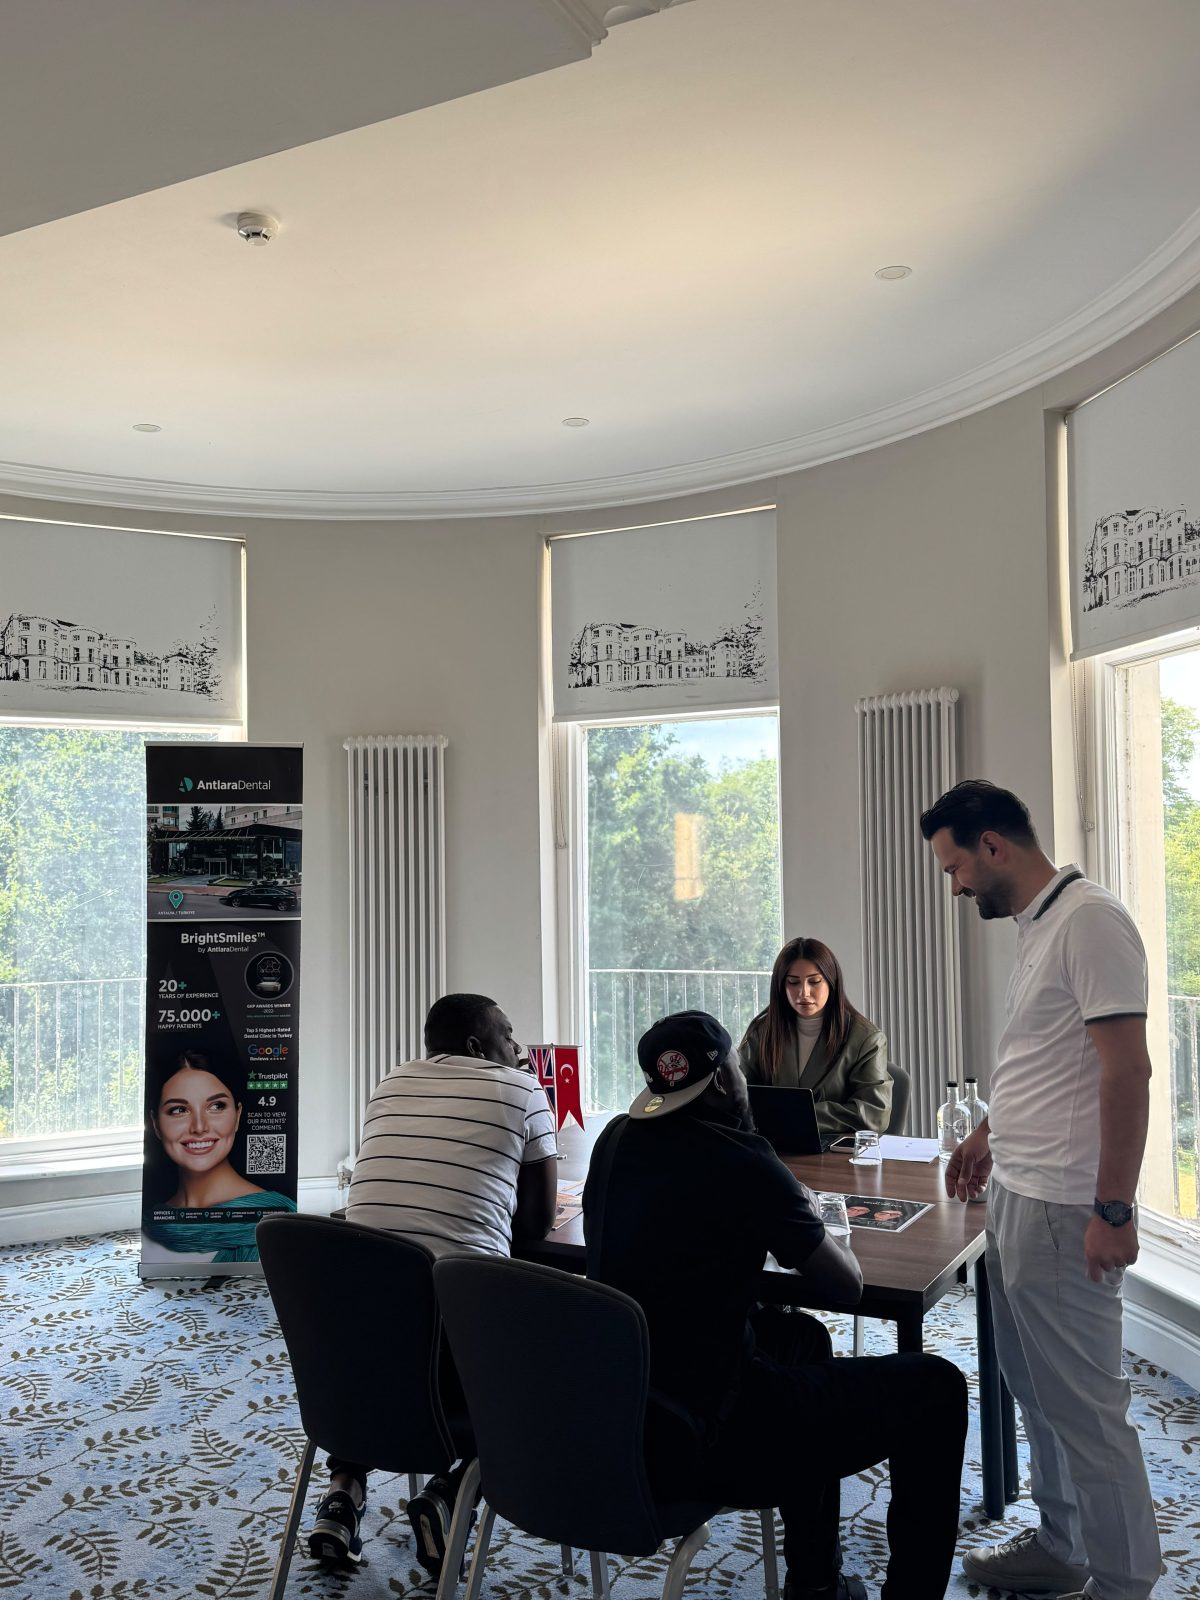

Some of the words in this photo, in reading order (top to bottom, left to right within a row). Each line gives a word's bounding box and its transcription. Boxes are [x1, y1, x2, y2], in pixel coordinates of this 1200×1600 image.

[197, 779, 271, 790] AntlaraDental
[159, 979, 187, 992] 20+
[159, 1009, 220, 1022] 75.000+
[248, 1044, 288, 1057] Google
[258, 1096, 277, 1106] 4.9
